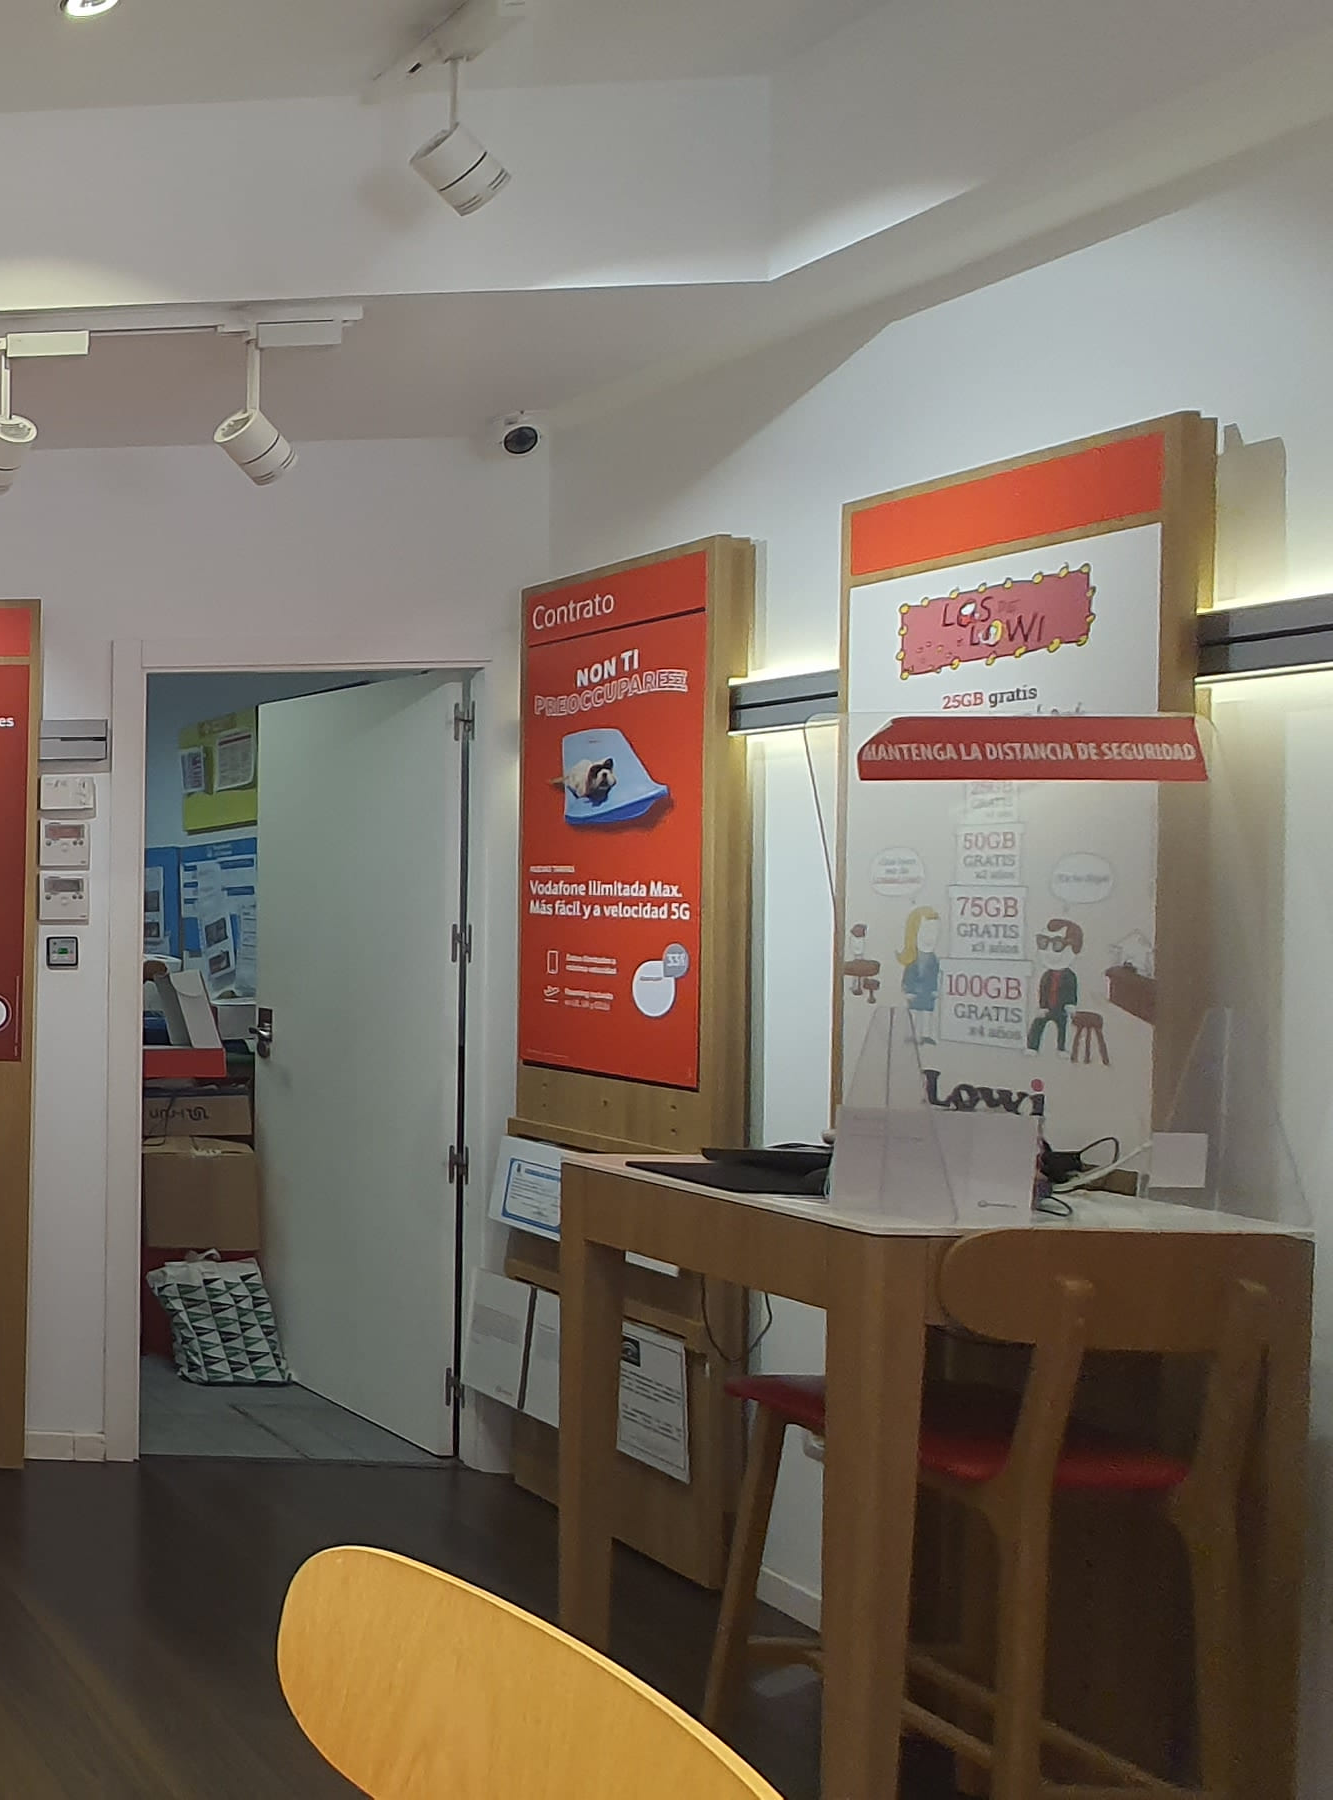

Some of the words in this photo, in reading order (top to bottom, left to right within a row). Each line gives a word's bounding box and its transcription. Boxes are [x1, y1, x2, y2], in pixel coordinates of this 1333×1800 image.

[533, 594, 615, 630] Contrato
[576, 657, 617, 688] NON
[621, 649, 639, 672] TI
[941, 692, 984, 710] 25GB
[988, 685, 1038, 708] gratis
[862, 743, 958, 761] MANTENGA
[961, 743, 983, 761] LA
[986, 743, 1077, 761] DISTANCIA
[1079, 743, 1101, 760] DE
[1103, 742, 1197, 761] SEGURIDAD
[963, 832, 1016, 850] 50GB
[963, 854, 1017, 867] GRATIS
[530, 880, 586, 896] Vodafone
[589, 880, 647, 896] Ilimitada
[650, 881, 683, 898] Max.
[530, 900, 553, 915] Más
[555, 900, 581, 915] fácil
[583, 904, 591, 919] y
[593, 906, 601, 916] a
[604, 902, 669, 919] velocidad
[670, 903, 691, 920] 5G
[957, 896, 1019, 918] 75GB
[957, 923, 1020, 940] GRATIS
[946, 974, 1022, 1000] 100GB
[953, 1003, 1023, 1024] GRATIS
[921, 1068, 1045, 1117] Lowi
